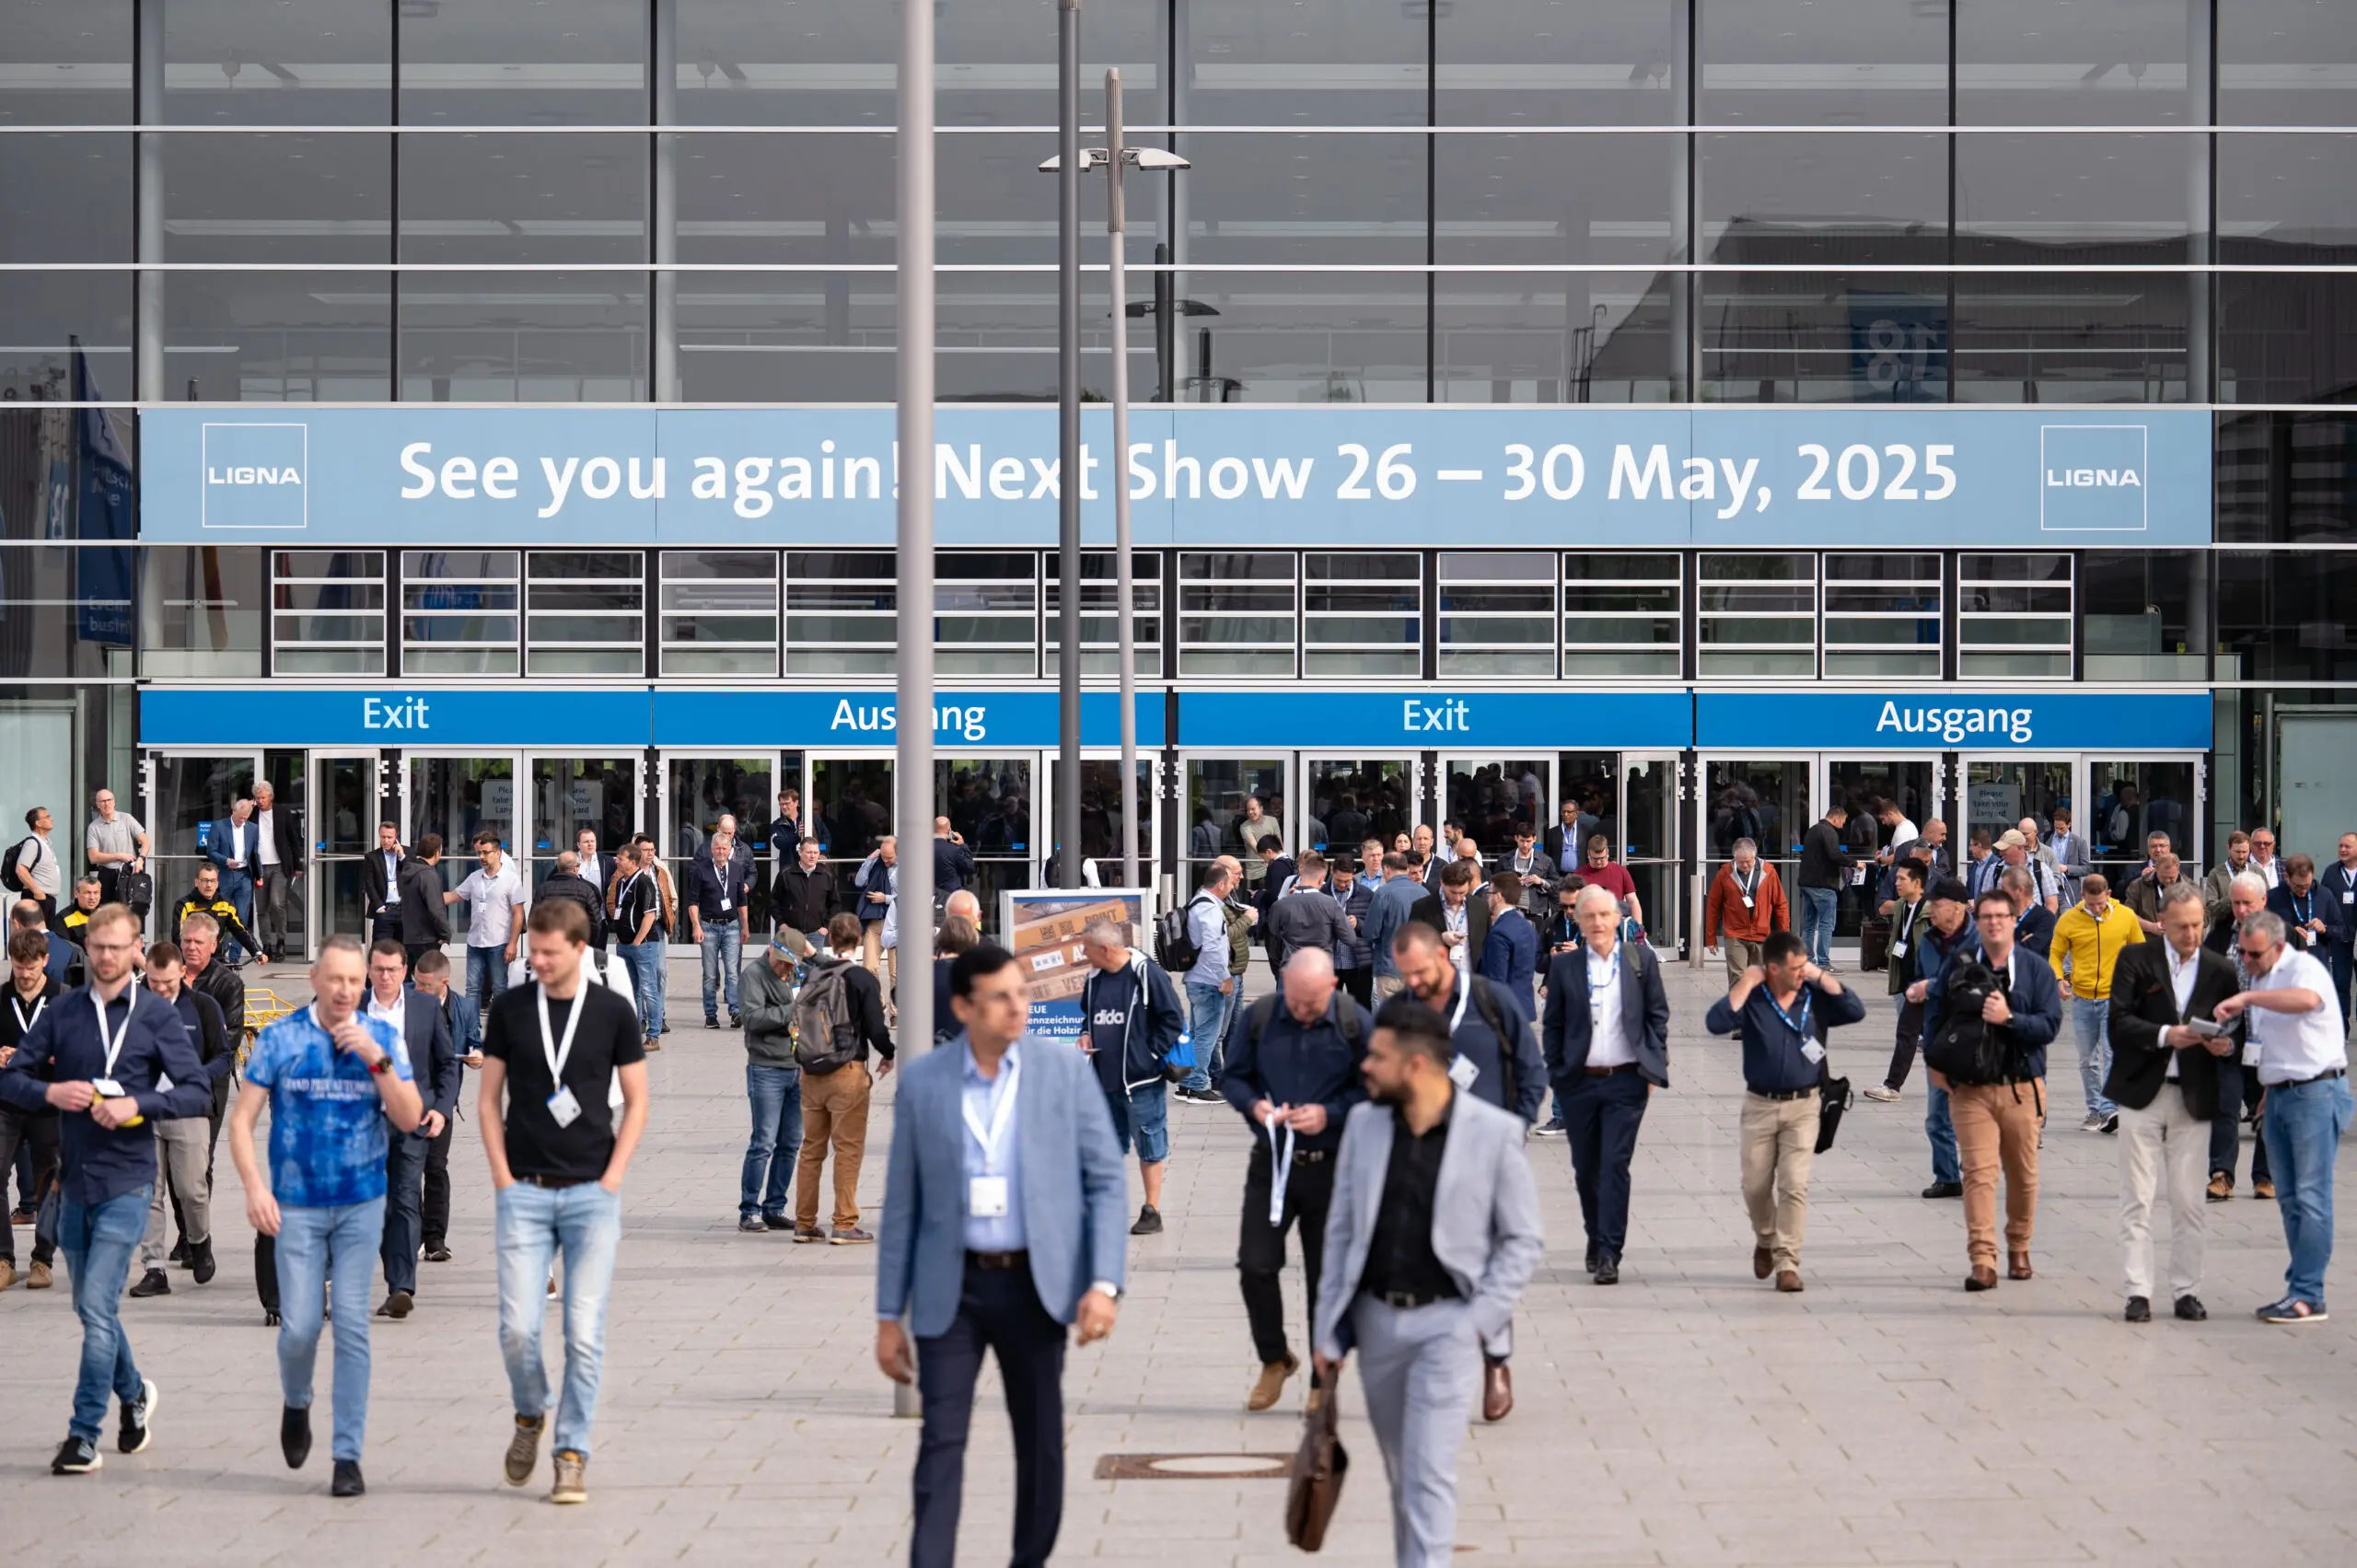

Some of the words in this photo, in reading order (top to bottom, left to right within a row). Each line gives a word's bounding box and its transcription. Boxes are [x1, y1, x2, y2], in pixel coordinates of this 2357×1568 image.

[208, 467, 301, 485] LIGNA
[400, 442, 518, 499] See
[538, 457, 666, 519] you
[935, 443, 1099, 500] Next
[1128, 438, 1314, 500] Show
[1337, 443, 1417, 500] 26
[1504, 443, 1585, 501] 30
[1608, 444, 1771, 519] May,
[1797, 444, 1956, 501] 2025
[2047, 468, 2142, 487] LIGNA
[364, 696, 429, 729] Exit
[830, 699, 986, 741] Ausng
[1403, 698, 1469, 731] Exit
[1875, 701, 2033, 743] Ausgang
[1028, 1005, 1047, 1014] EUE
[1093, 1009, 1124, 1025] dida
[1027, 1015, 1085, 1025] ennzeichnu
[1024, 1026, 1035, 1035] ür
[1037, 1026, 1051, 1035] die
